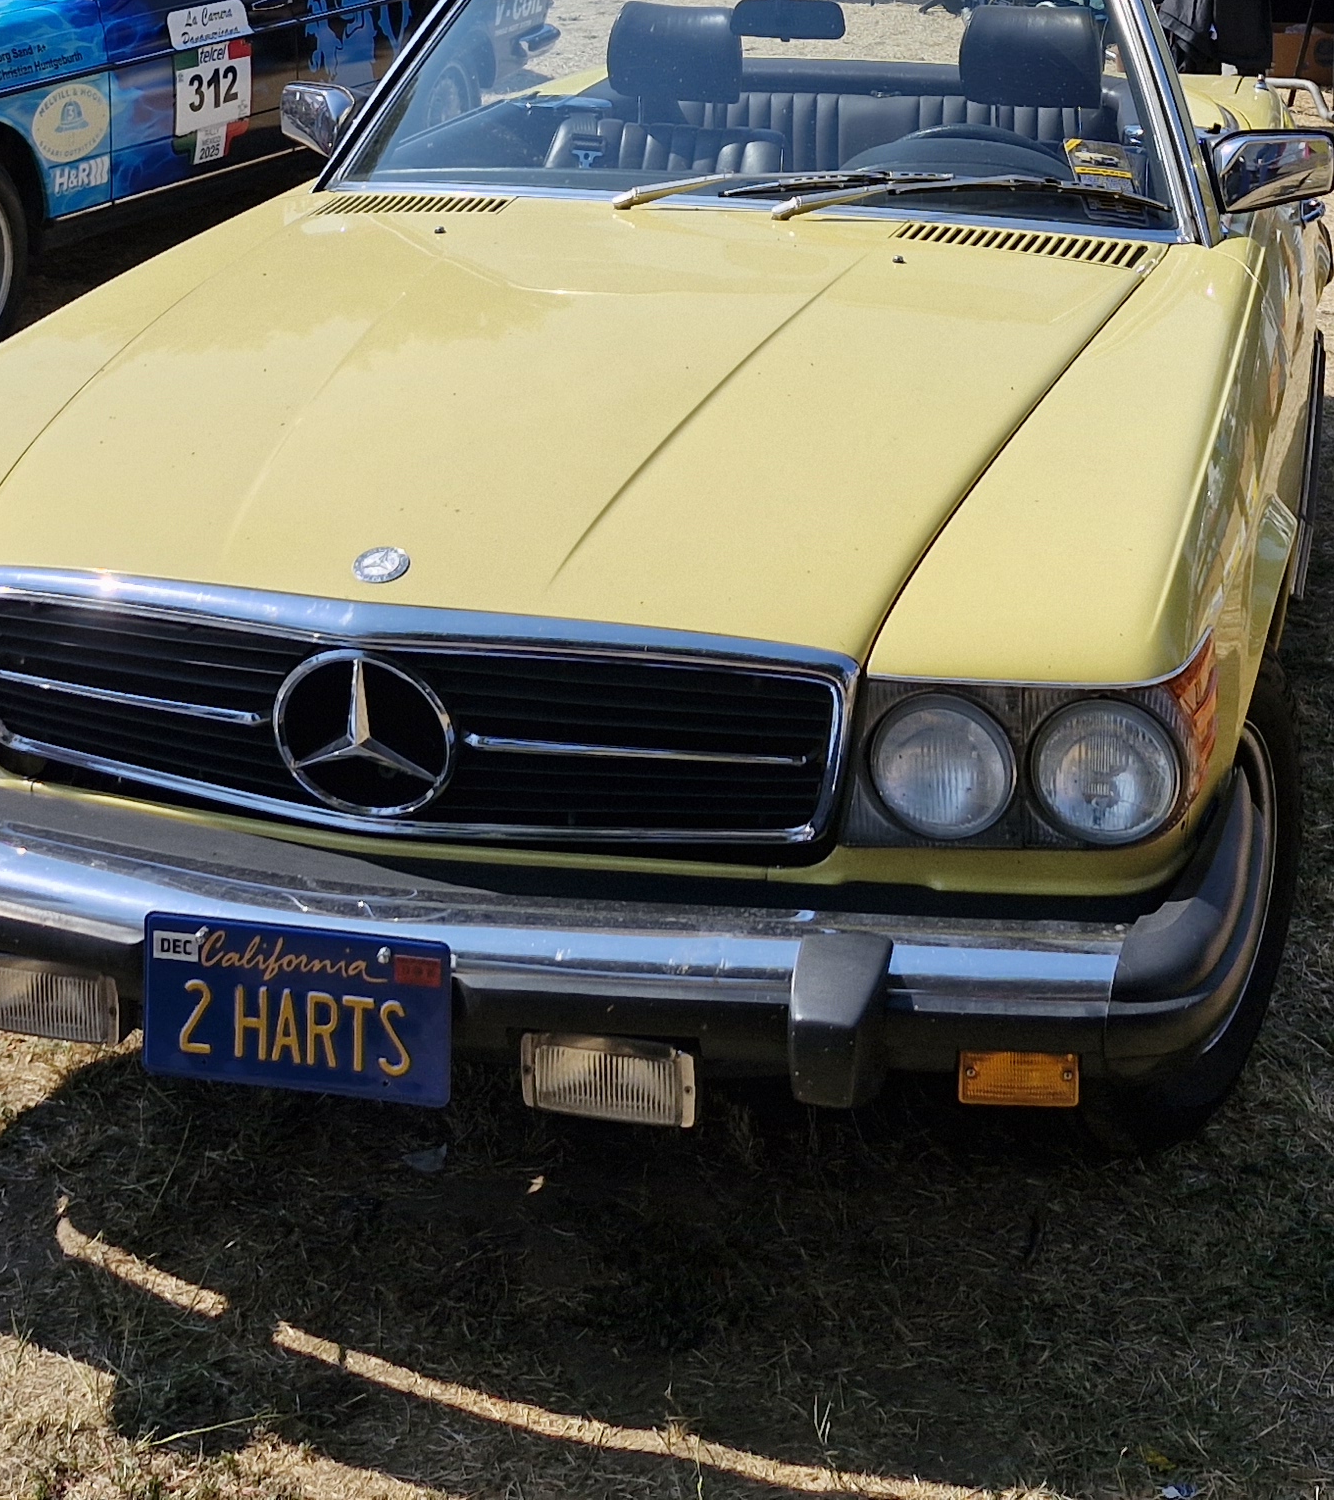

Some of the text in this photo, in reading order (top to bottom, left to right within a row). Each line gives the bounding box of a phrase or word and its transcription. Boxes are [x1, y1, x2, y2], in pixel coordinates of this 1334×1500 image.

[184, 7, 233, 27] La Carrera
[11, 45, 34, 58] Sand
[199, 44, 227, 64] telcel
[189, 65, 239, 113] 312
[199, 144, 220, 161] 2025
[55, 162, 90, 195] H&R
[160, 937, 193, 955] DEC
[200, 930, 388, 981] California
[179, 978, 411, 1078] 2 HARTS
